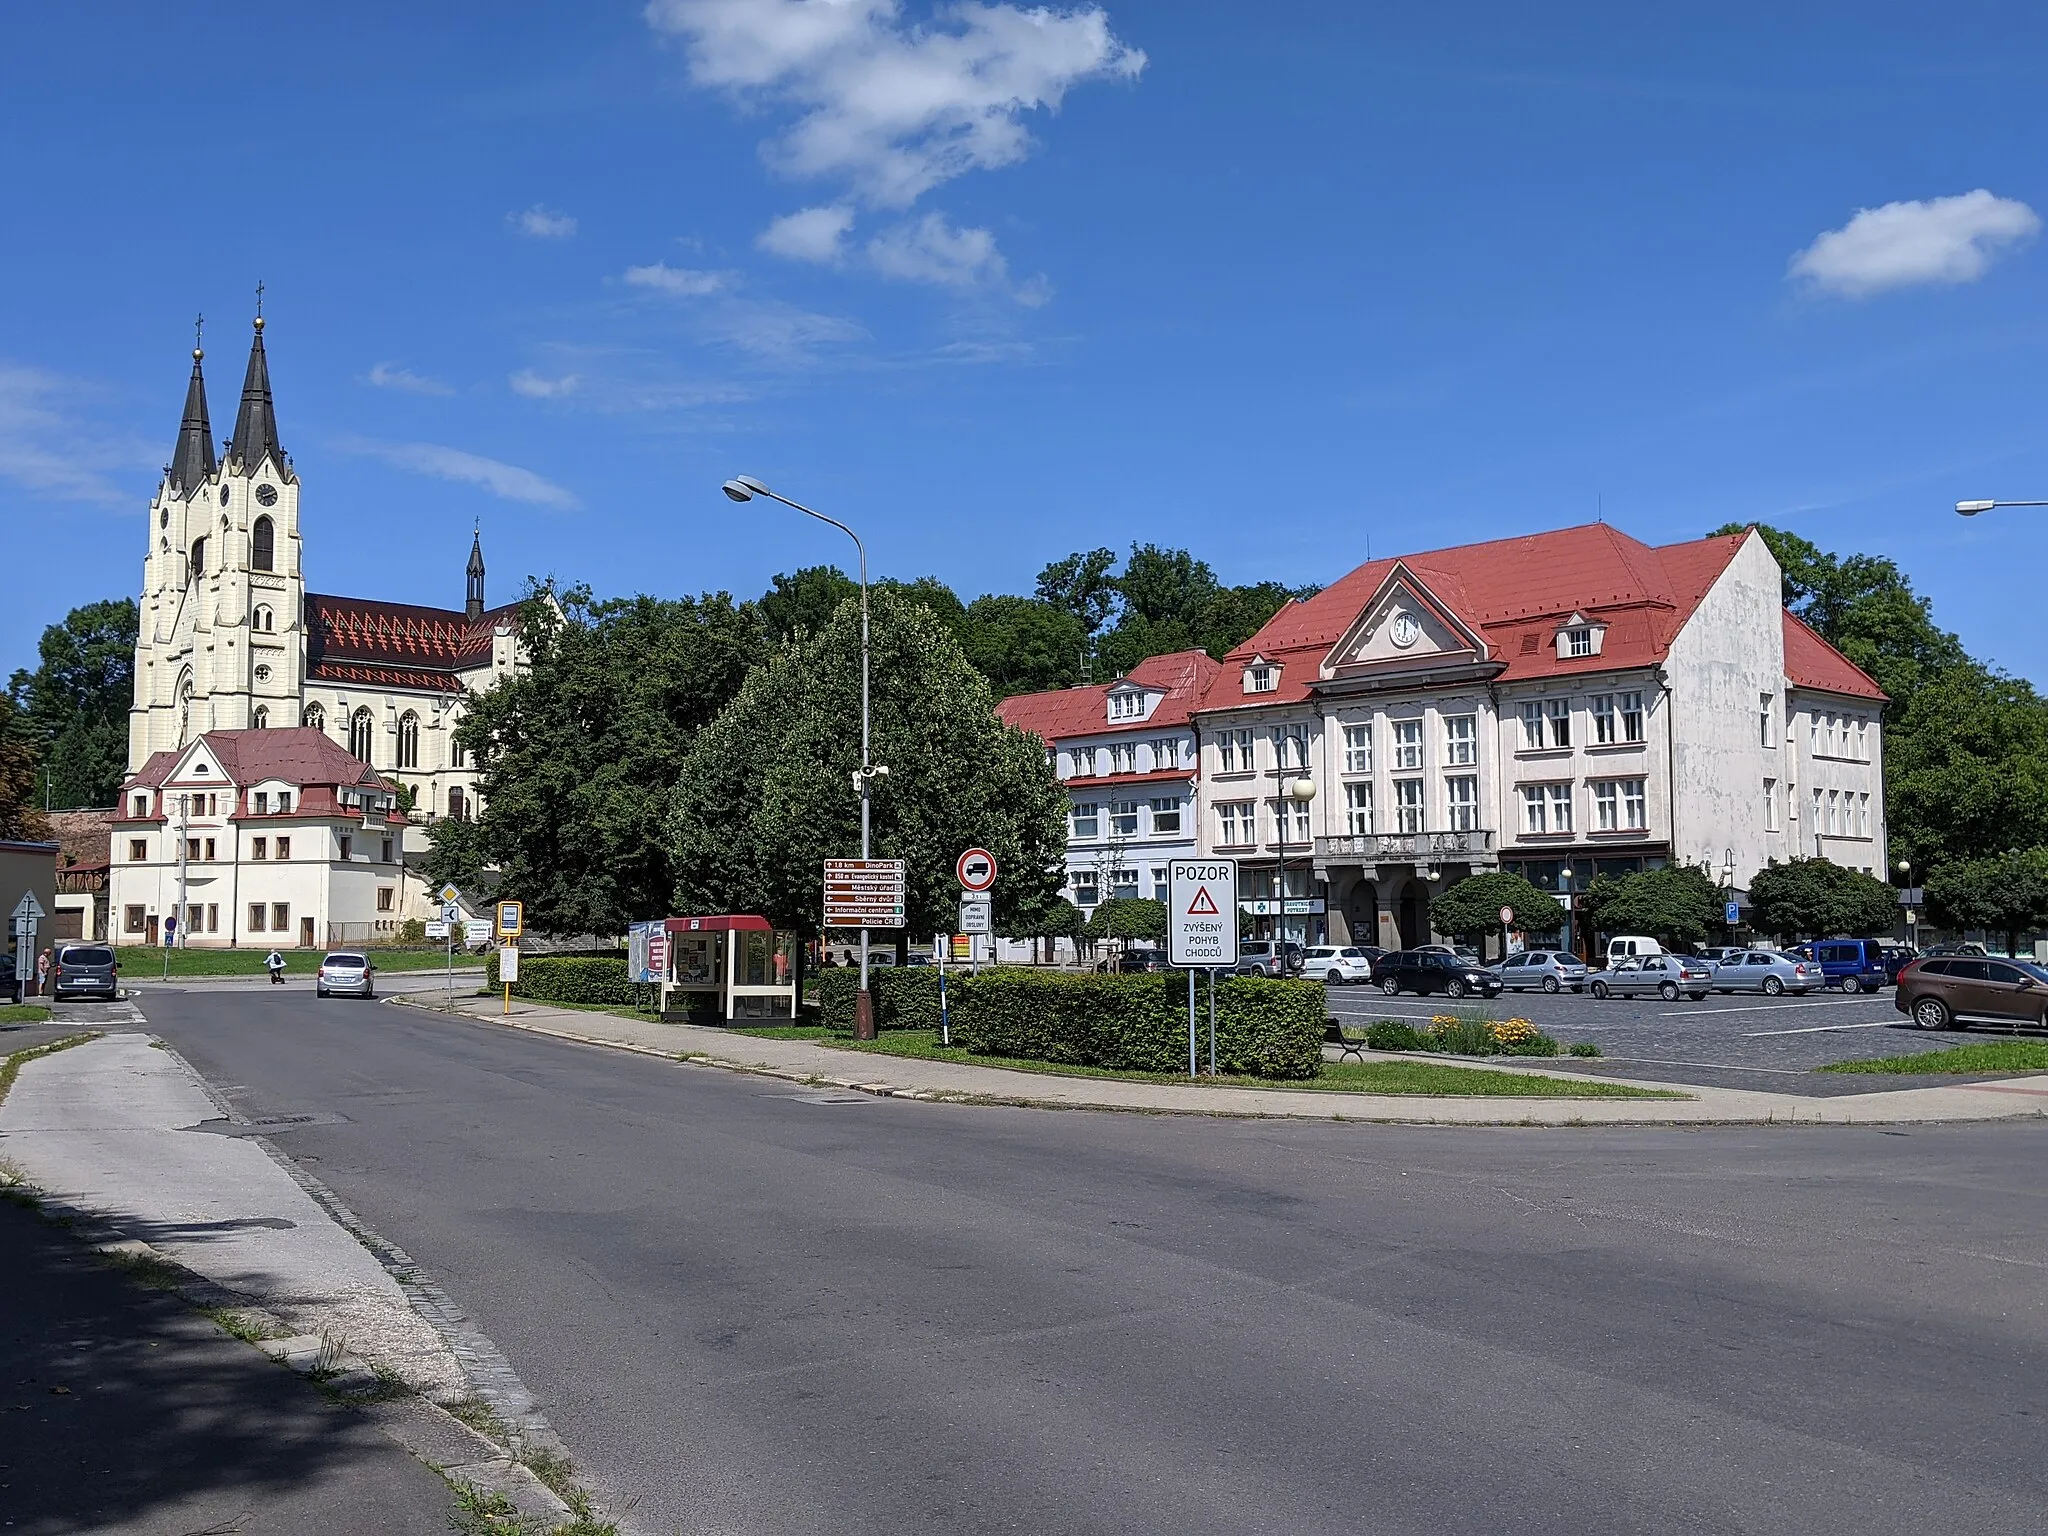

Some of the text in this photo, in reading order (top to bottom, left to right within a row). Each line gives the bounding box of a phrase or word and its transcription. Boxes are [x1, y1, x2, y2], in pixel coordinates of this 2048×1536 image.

[851, 873, 879, 881] Evangelický
[1175, 866, 1229, 881] POZOR
[851, 884, 878, 892] Městský
[854, 895, 878, 903] Sběrný
[1728, 904, 1736, 915] P
[861, 916, 894, 925] Policie ČR
[1183, 922, 1223, 932] ZVÝŠENÝ
[1189, 936, 1219, 945] POHYB
[1185, 946, 1222, 957] CHODCŮ
